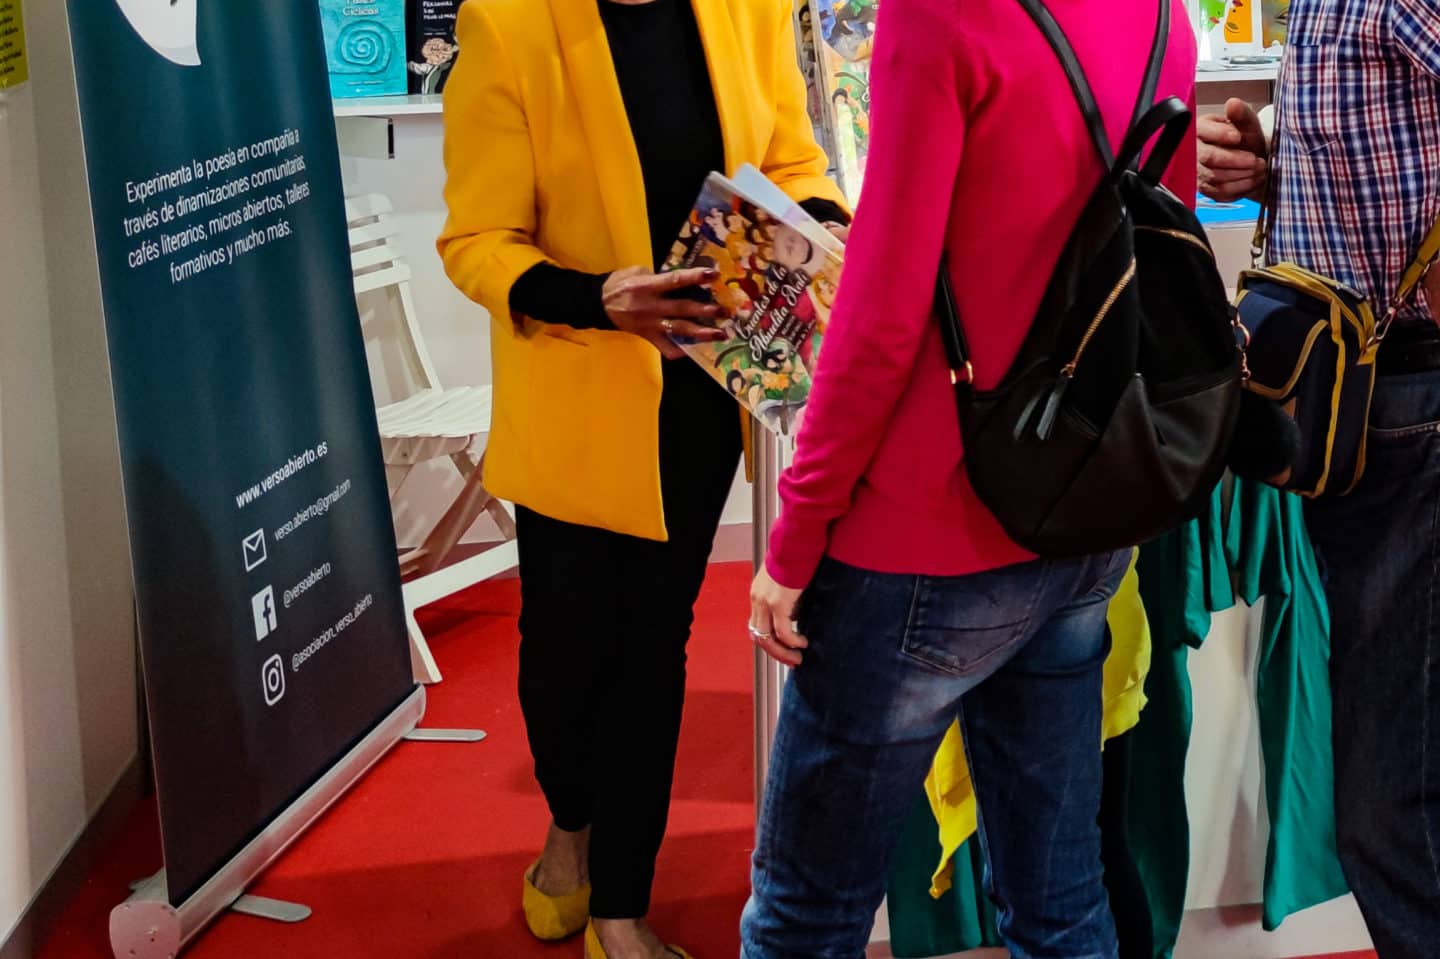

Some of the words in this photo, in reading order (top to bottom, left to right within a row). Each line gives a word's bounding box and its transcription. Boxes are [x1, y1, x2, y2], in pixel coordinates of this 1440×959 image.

[124, 207, 159, 238] través
[160, 202, 175, 224] de
[176, 175, 250, 218] dinamizaciones
[125, 164, 192, 204] Experimenta
[193, 159, 204, 179] la
[205, 148, 237, 180] poesía
[236, 147, 250, 164] en
[128, 240, 160, 269] cafés
[161, 218, 208, 256] literarios,
[208, 208, 243, 236] micros
[242, 194, 286, 223] abiertos,
[170, 247, 226, 285] formativos
[226, 244, 234, 265] y
[234, 225, 266, 257] mucho
[236, 441, 328, 510] www.versoabierto.es
